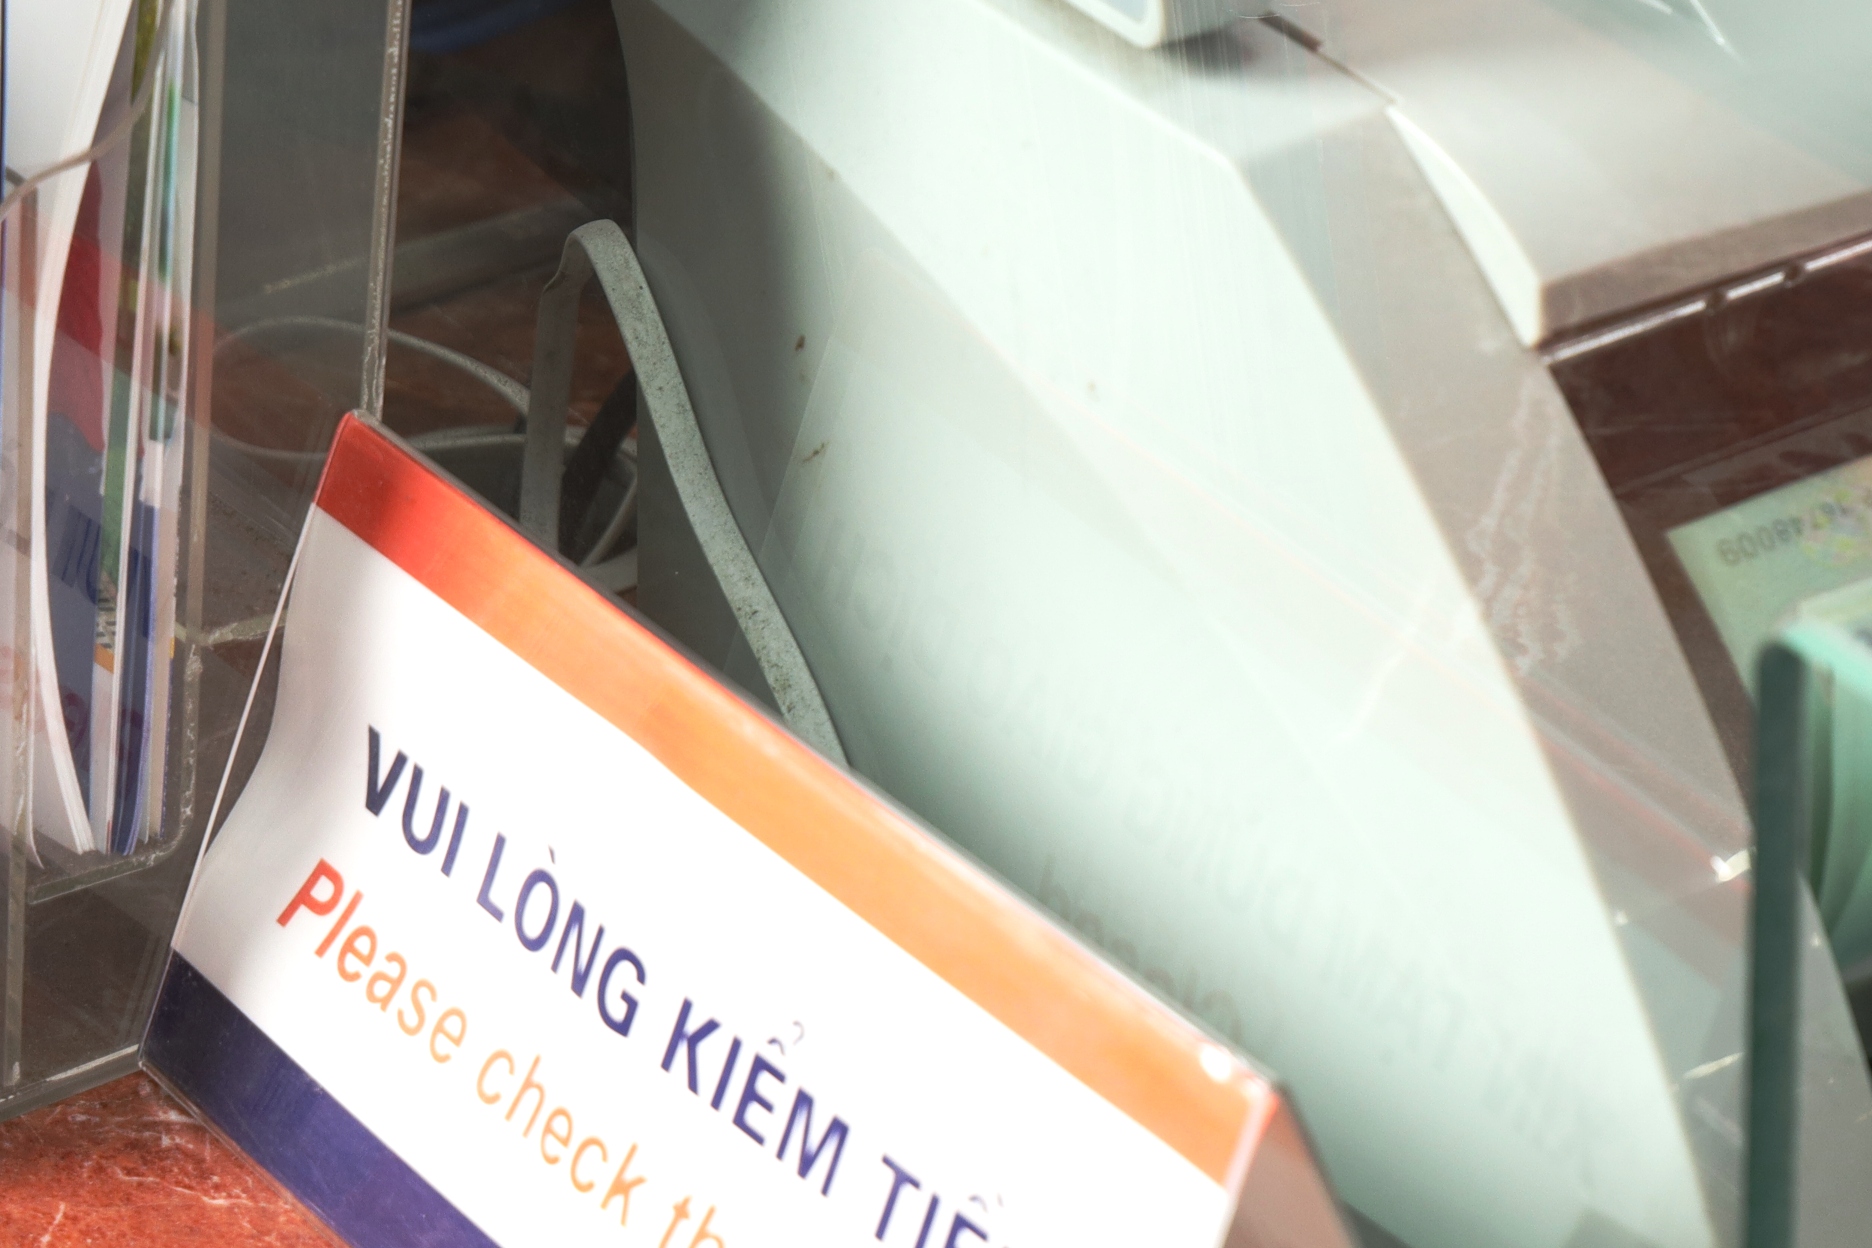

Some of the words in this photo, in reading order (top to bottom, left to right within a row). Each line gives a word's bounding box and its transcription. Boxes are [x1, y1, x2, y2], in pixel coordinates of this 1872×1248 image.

[275, 857, 470, 1065] Please
[475, 1045, 648, 1227] check
[363, 724, 472, 878] VUI
[475, 830, 648, 1039] LÒNG
[659, 997, 852, 1198] KIỂM
